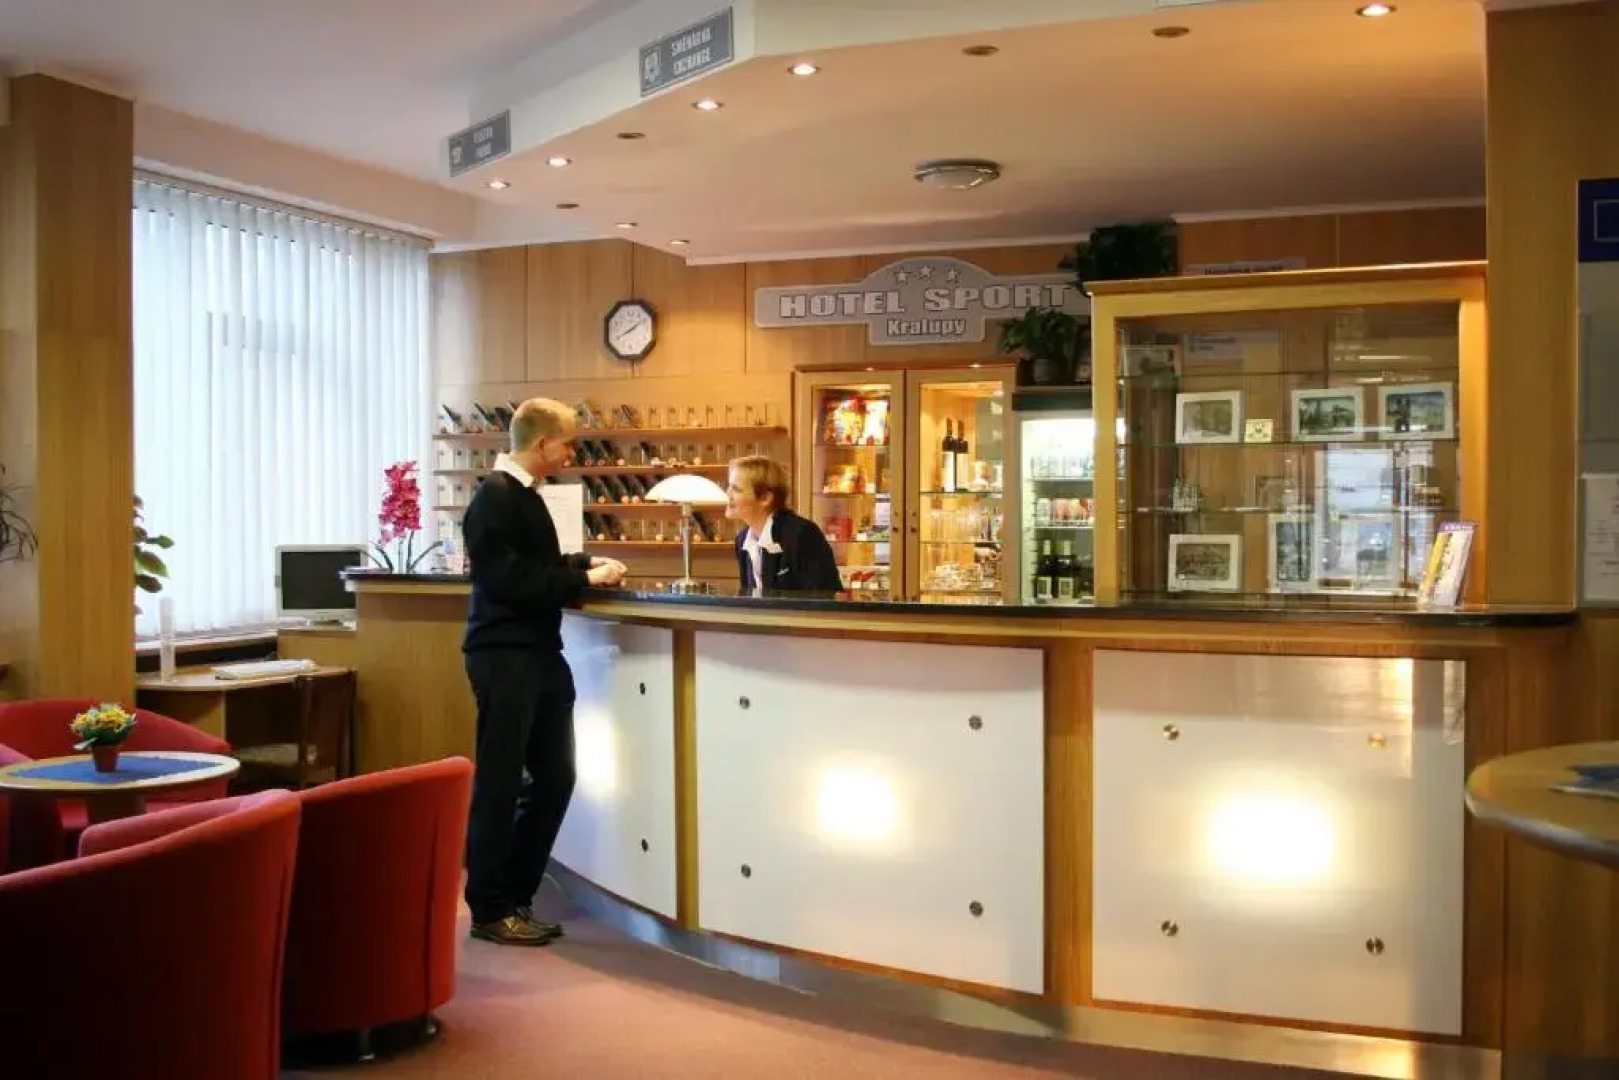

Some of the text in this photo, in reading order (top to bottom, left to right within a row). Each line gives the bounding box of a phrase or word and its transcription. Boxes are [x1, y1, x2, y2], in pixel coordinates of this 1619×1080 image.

[779, 284, 1071, 318] HOTEL SPORT
[887, 318, 966, 337] Kralupy
